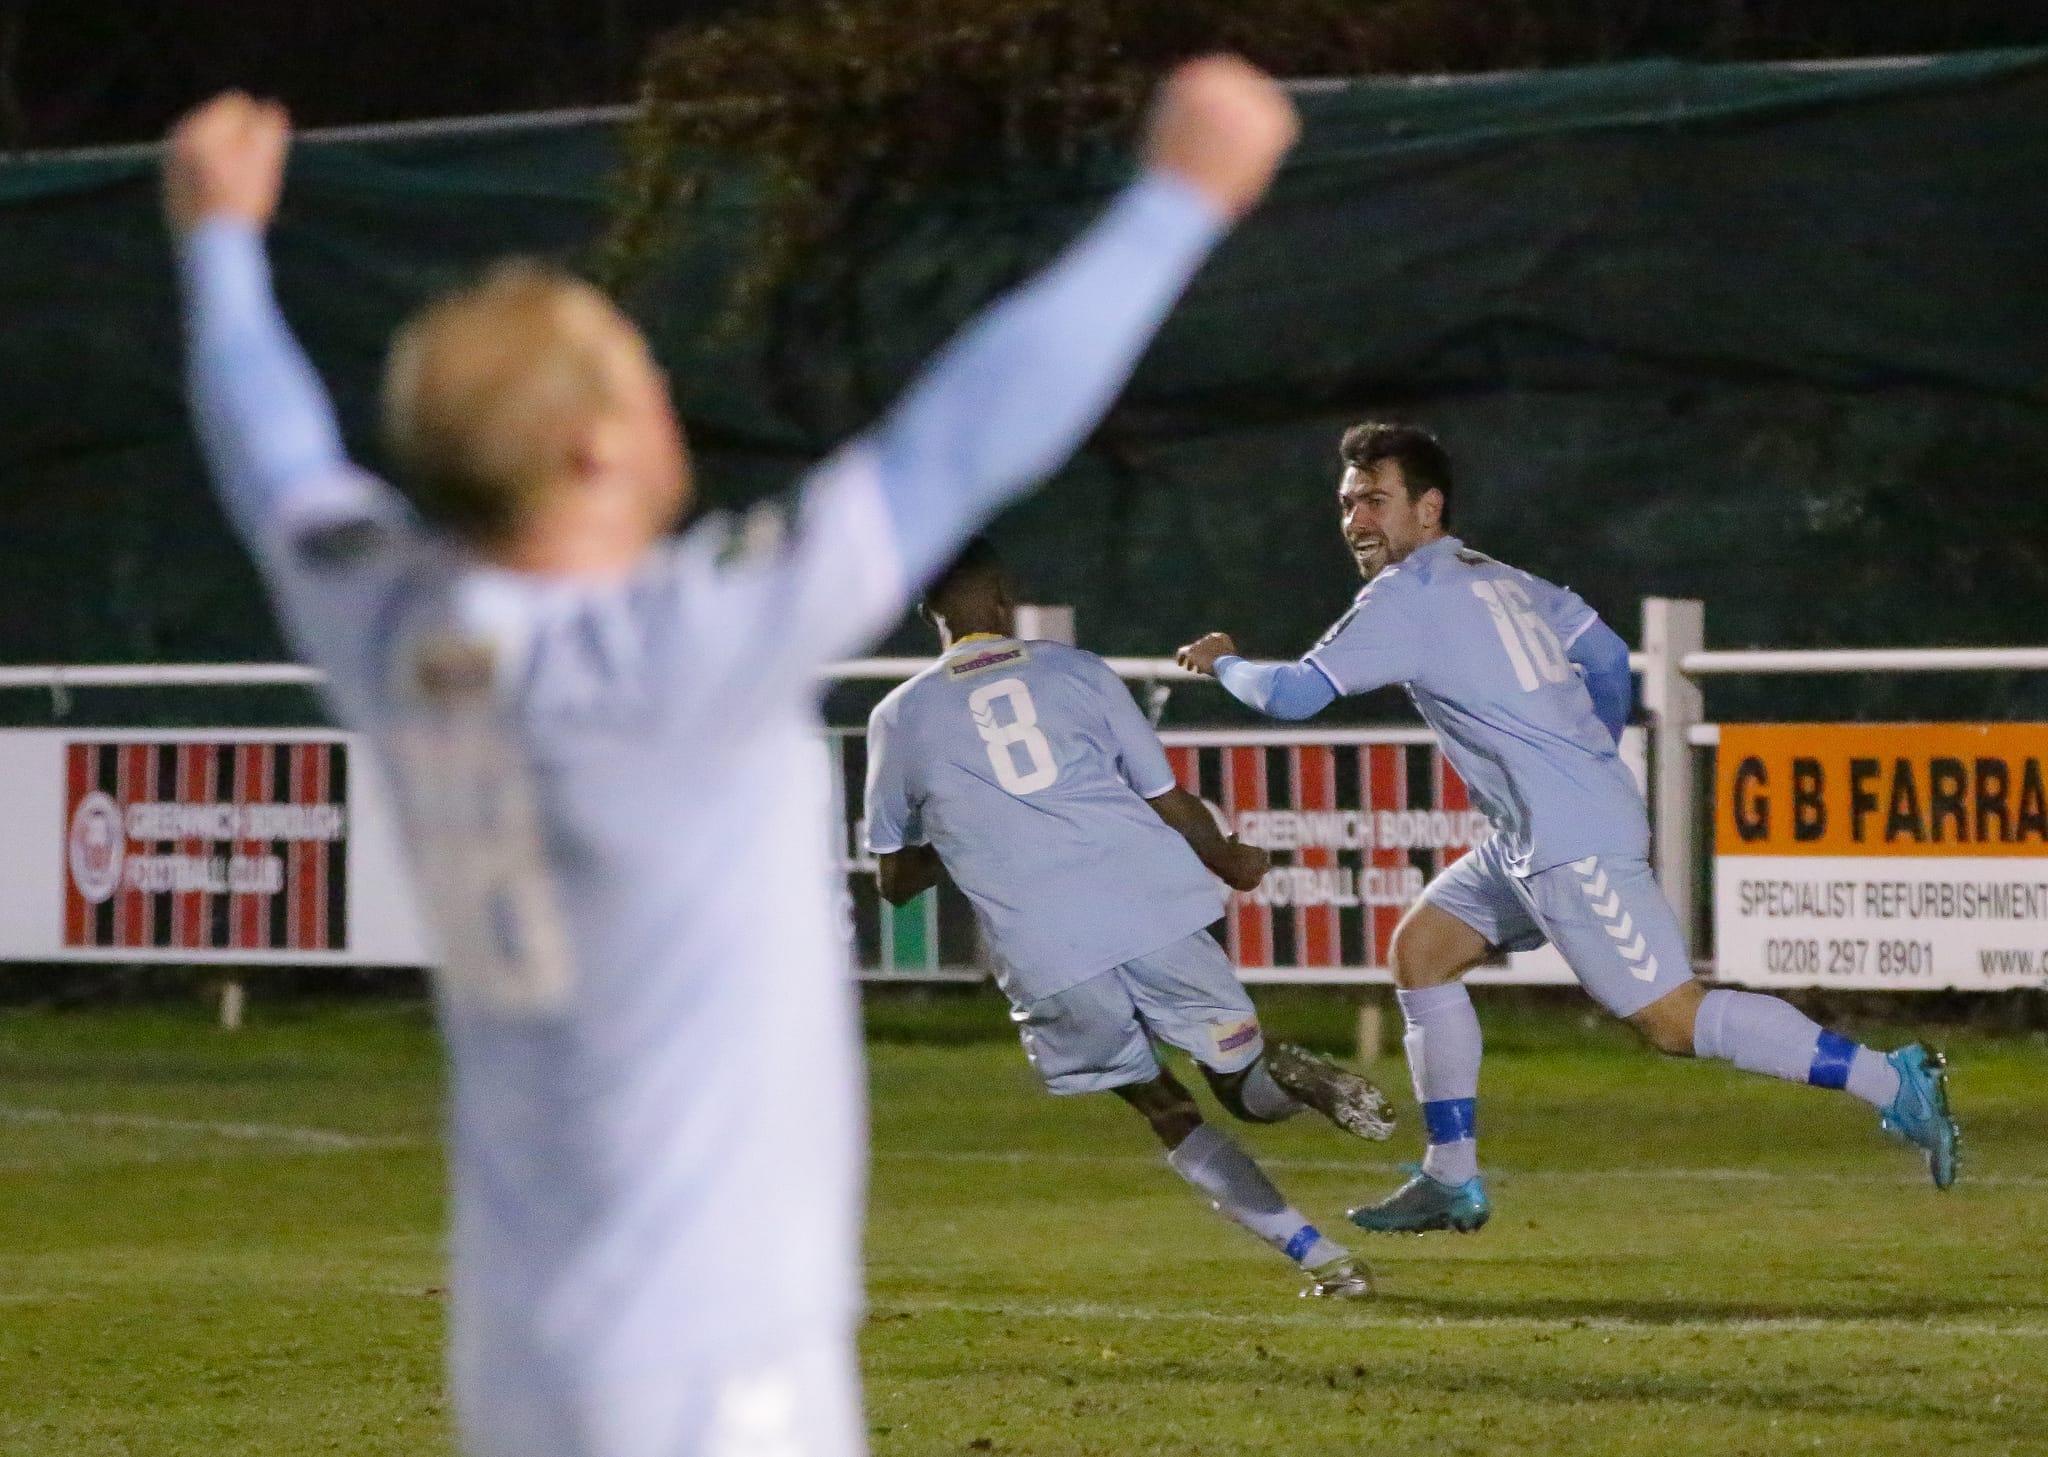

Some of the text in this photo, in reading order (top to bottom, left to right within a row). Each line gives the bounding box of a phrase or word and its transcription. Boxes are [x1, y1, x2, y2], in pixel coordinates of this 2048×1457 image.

[1471, 579, 1569, 692] 16
[969, 678, 1058, 795] 8
[1733, 755, 2048, 843] G B FARRA
[1239, 810, 1373, 848] GREENWICH
[1252, 867, 1424, 906] OOTBALL CLUB
[1740, 880, 1857, 918] SPECIALIST
[1767, 938, 1934, 975] 0208 297 8901
